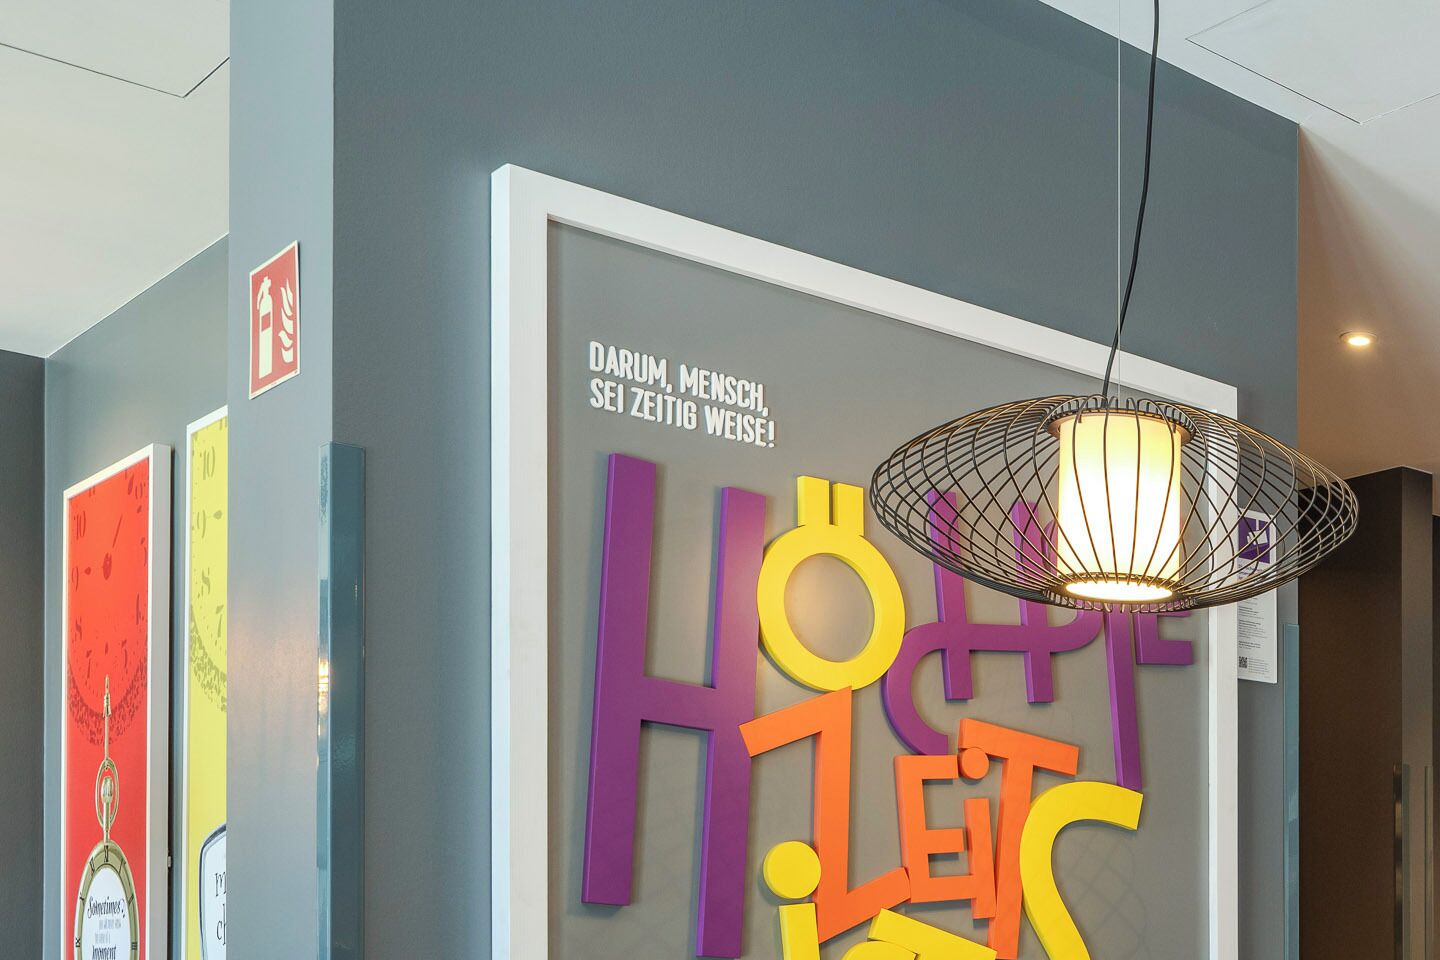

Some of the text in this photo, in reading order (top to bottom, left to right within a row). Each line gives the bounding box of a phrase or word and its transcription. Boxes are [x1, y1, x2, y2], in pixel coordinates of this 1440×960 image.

[589, 341, 769, 418] DARUM, MENSCH,
[589, 378, 775, 449] SEI ZEITIG WEISE!
